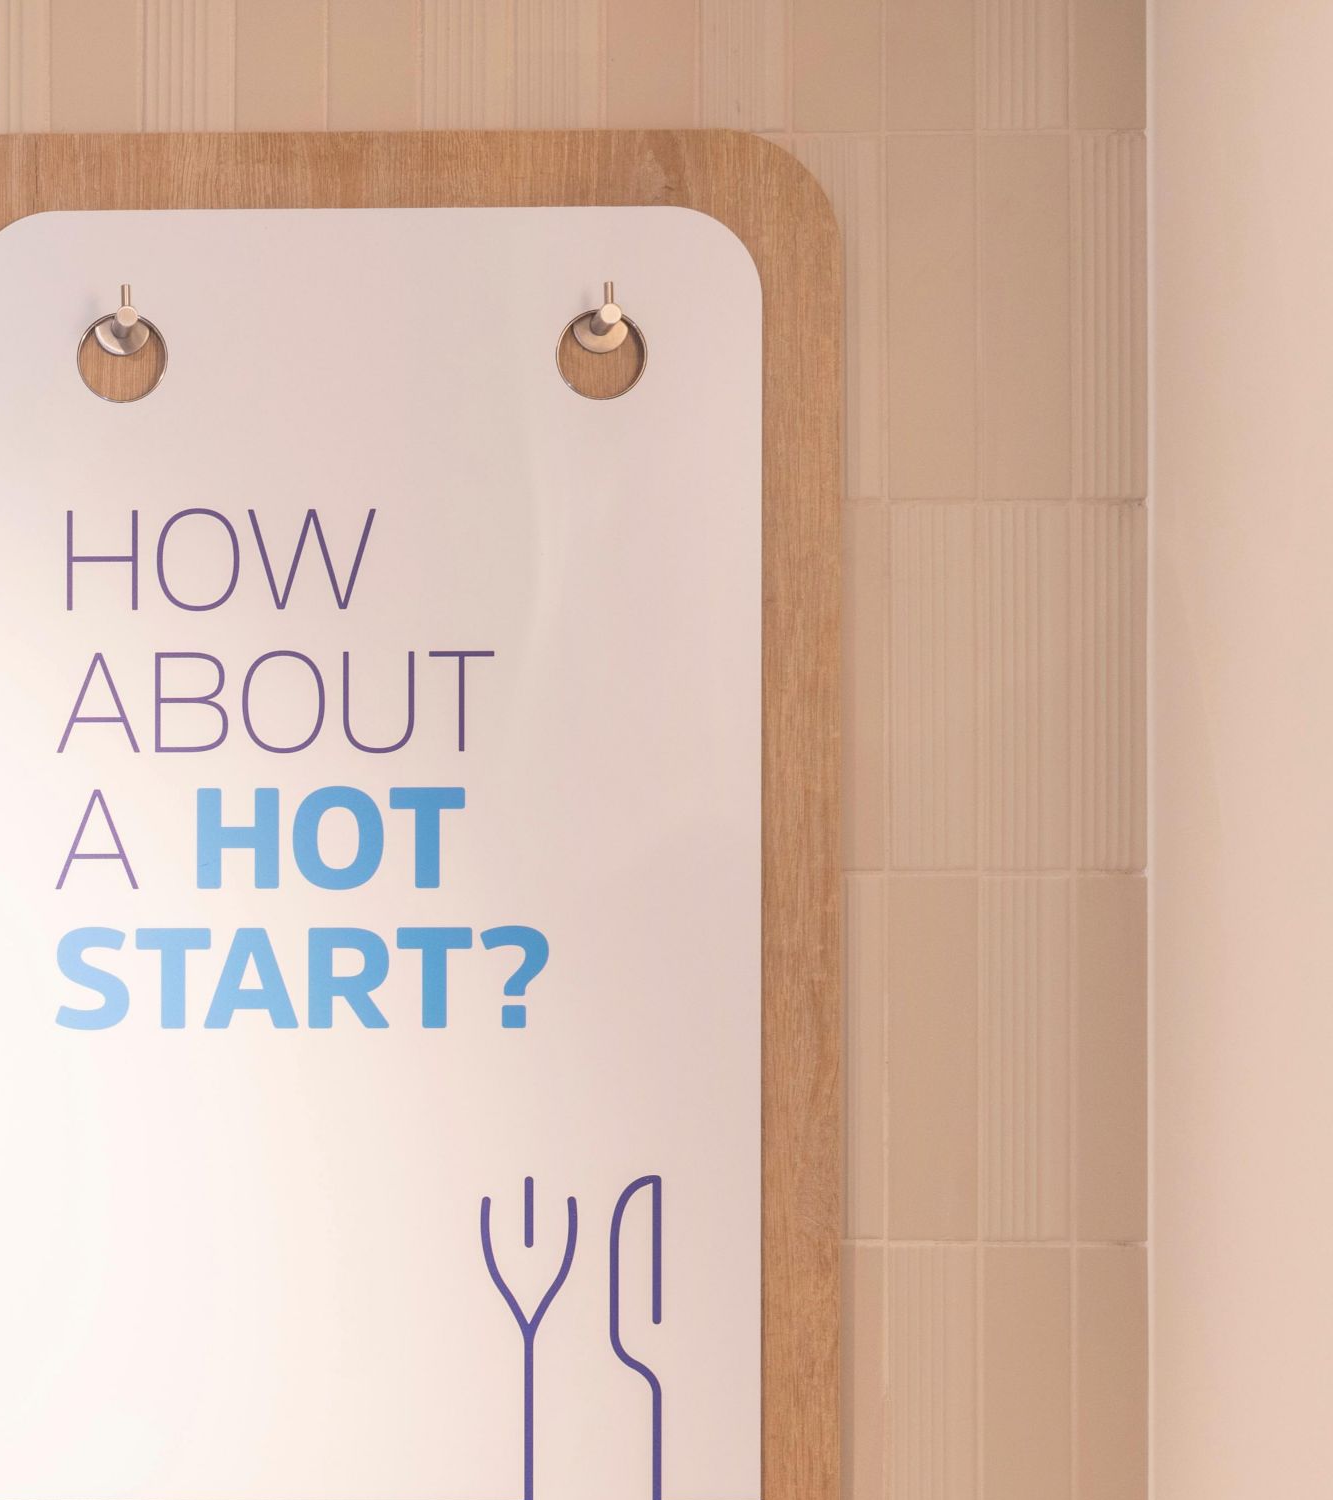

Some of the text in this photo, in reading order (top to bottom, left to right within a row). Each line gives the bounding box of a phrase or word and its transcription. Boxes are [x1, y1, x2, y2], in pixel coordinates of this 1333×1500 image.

[66, 508, 377, 612] HOW
[56, 650, 495, 754] ABOUT
[55, 785, 466, 891] A HOT
[54, 925, 550, 1031] START?
